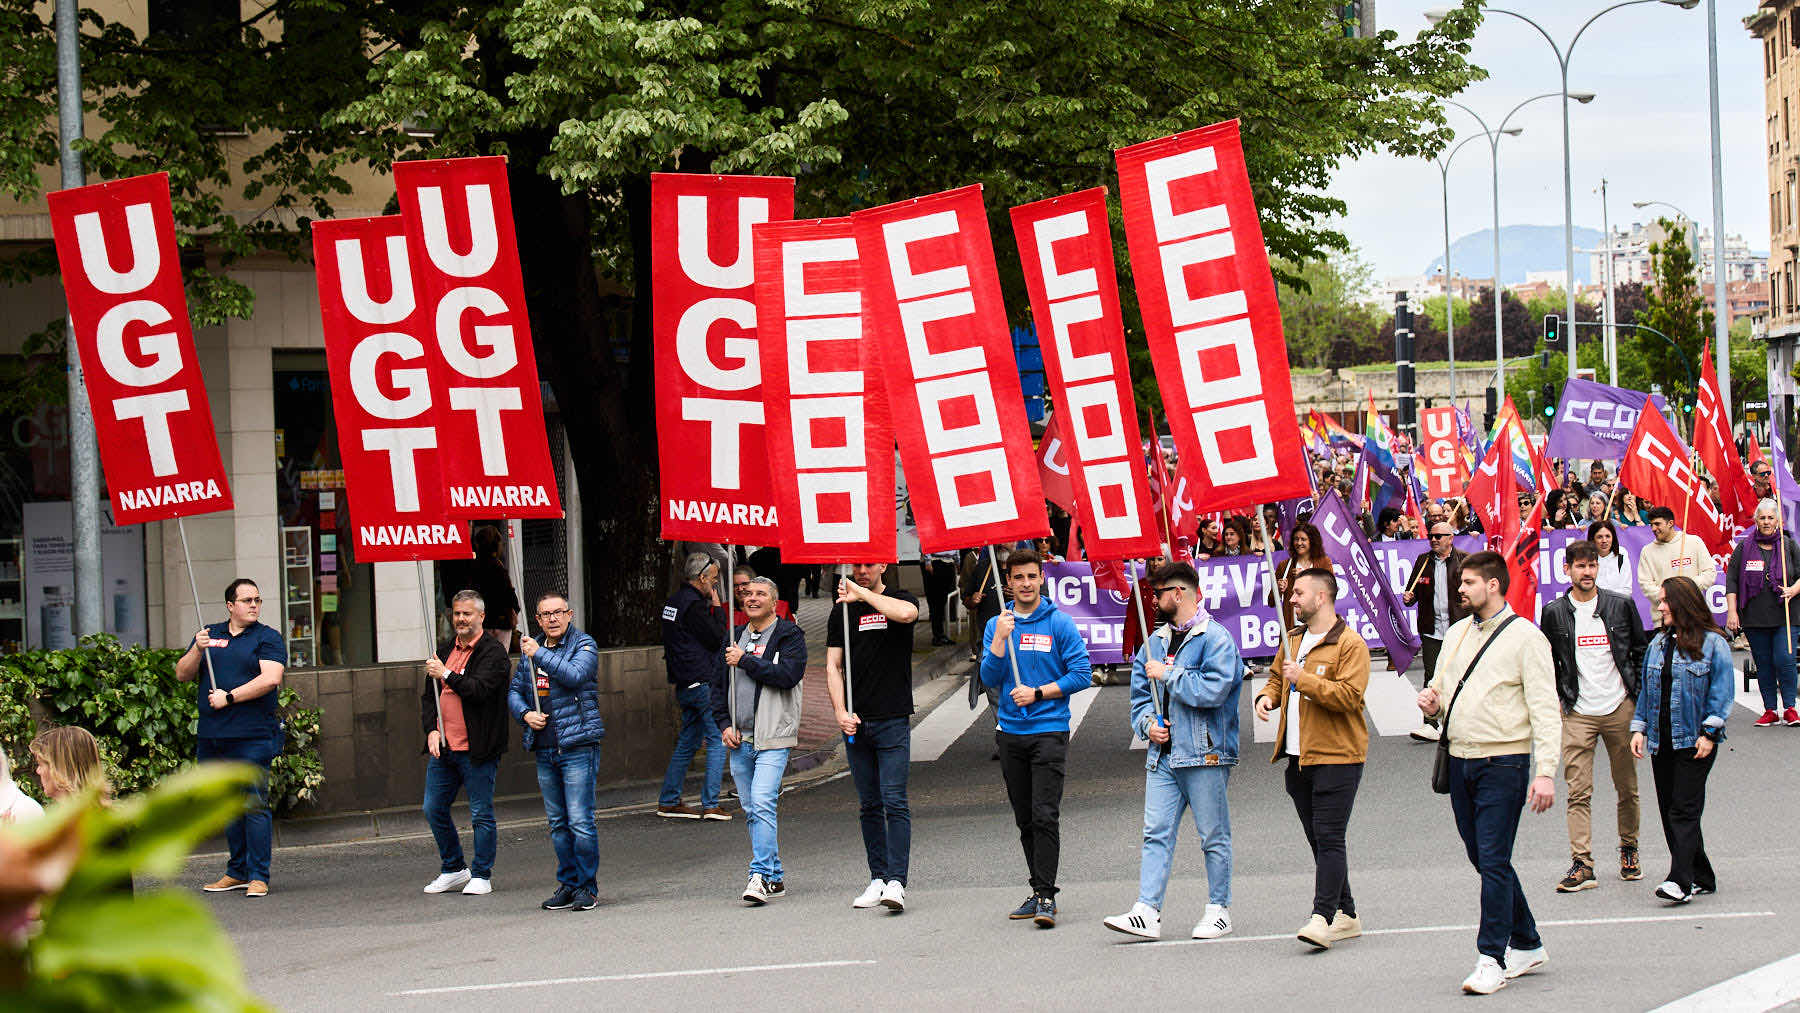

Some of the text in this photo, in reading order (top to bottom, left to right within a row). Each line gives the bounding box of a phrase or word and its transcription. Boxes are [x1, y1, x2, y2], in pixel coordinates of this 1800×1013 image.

[75, 203, 189, 476] UGT
[418, 185, 522, 475] UGT
[677, 196, 768, 489] UGT
[1145, 146, 1278, 486] CCOO
[336, 236, 437, 512] UGT
[783, 238, 869, 543] CCOO
[883, 211, 1018, 529] CCOO
[1034, 211, 1142, 539] CCOO
[1562, 400, 1641, 429] CCO
[1427, 413, 1456, 493] UGT
[120, 480, 221, 510] NAVARRA
[451, 486, 550, 507] NAVARRA
[670, 500, 779, 527] NAVARRA
[361, 525, 461, 546] NAVARRA
[860, 614, 886, 625] CCOO
[1348, 564, 1378, 617] NAVARRA
[1022, 635, 1050, 646] CCOO
[1580, 636, 1608, 645] CCOO
